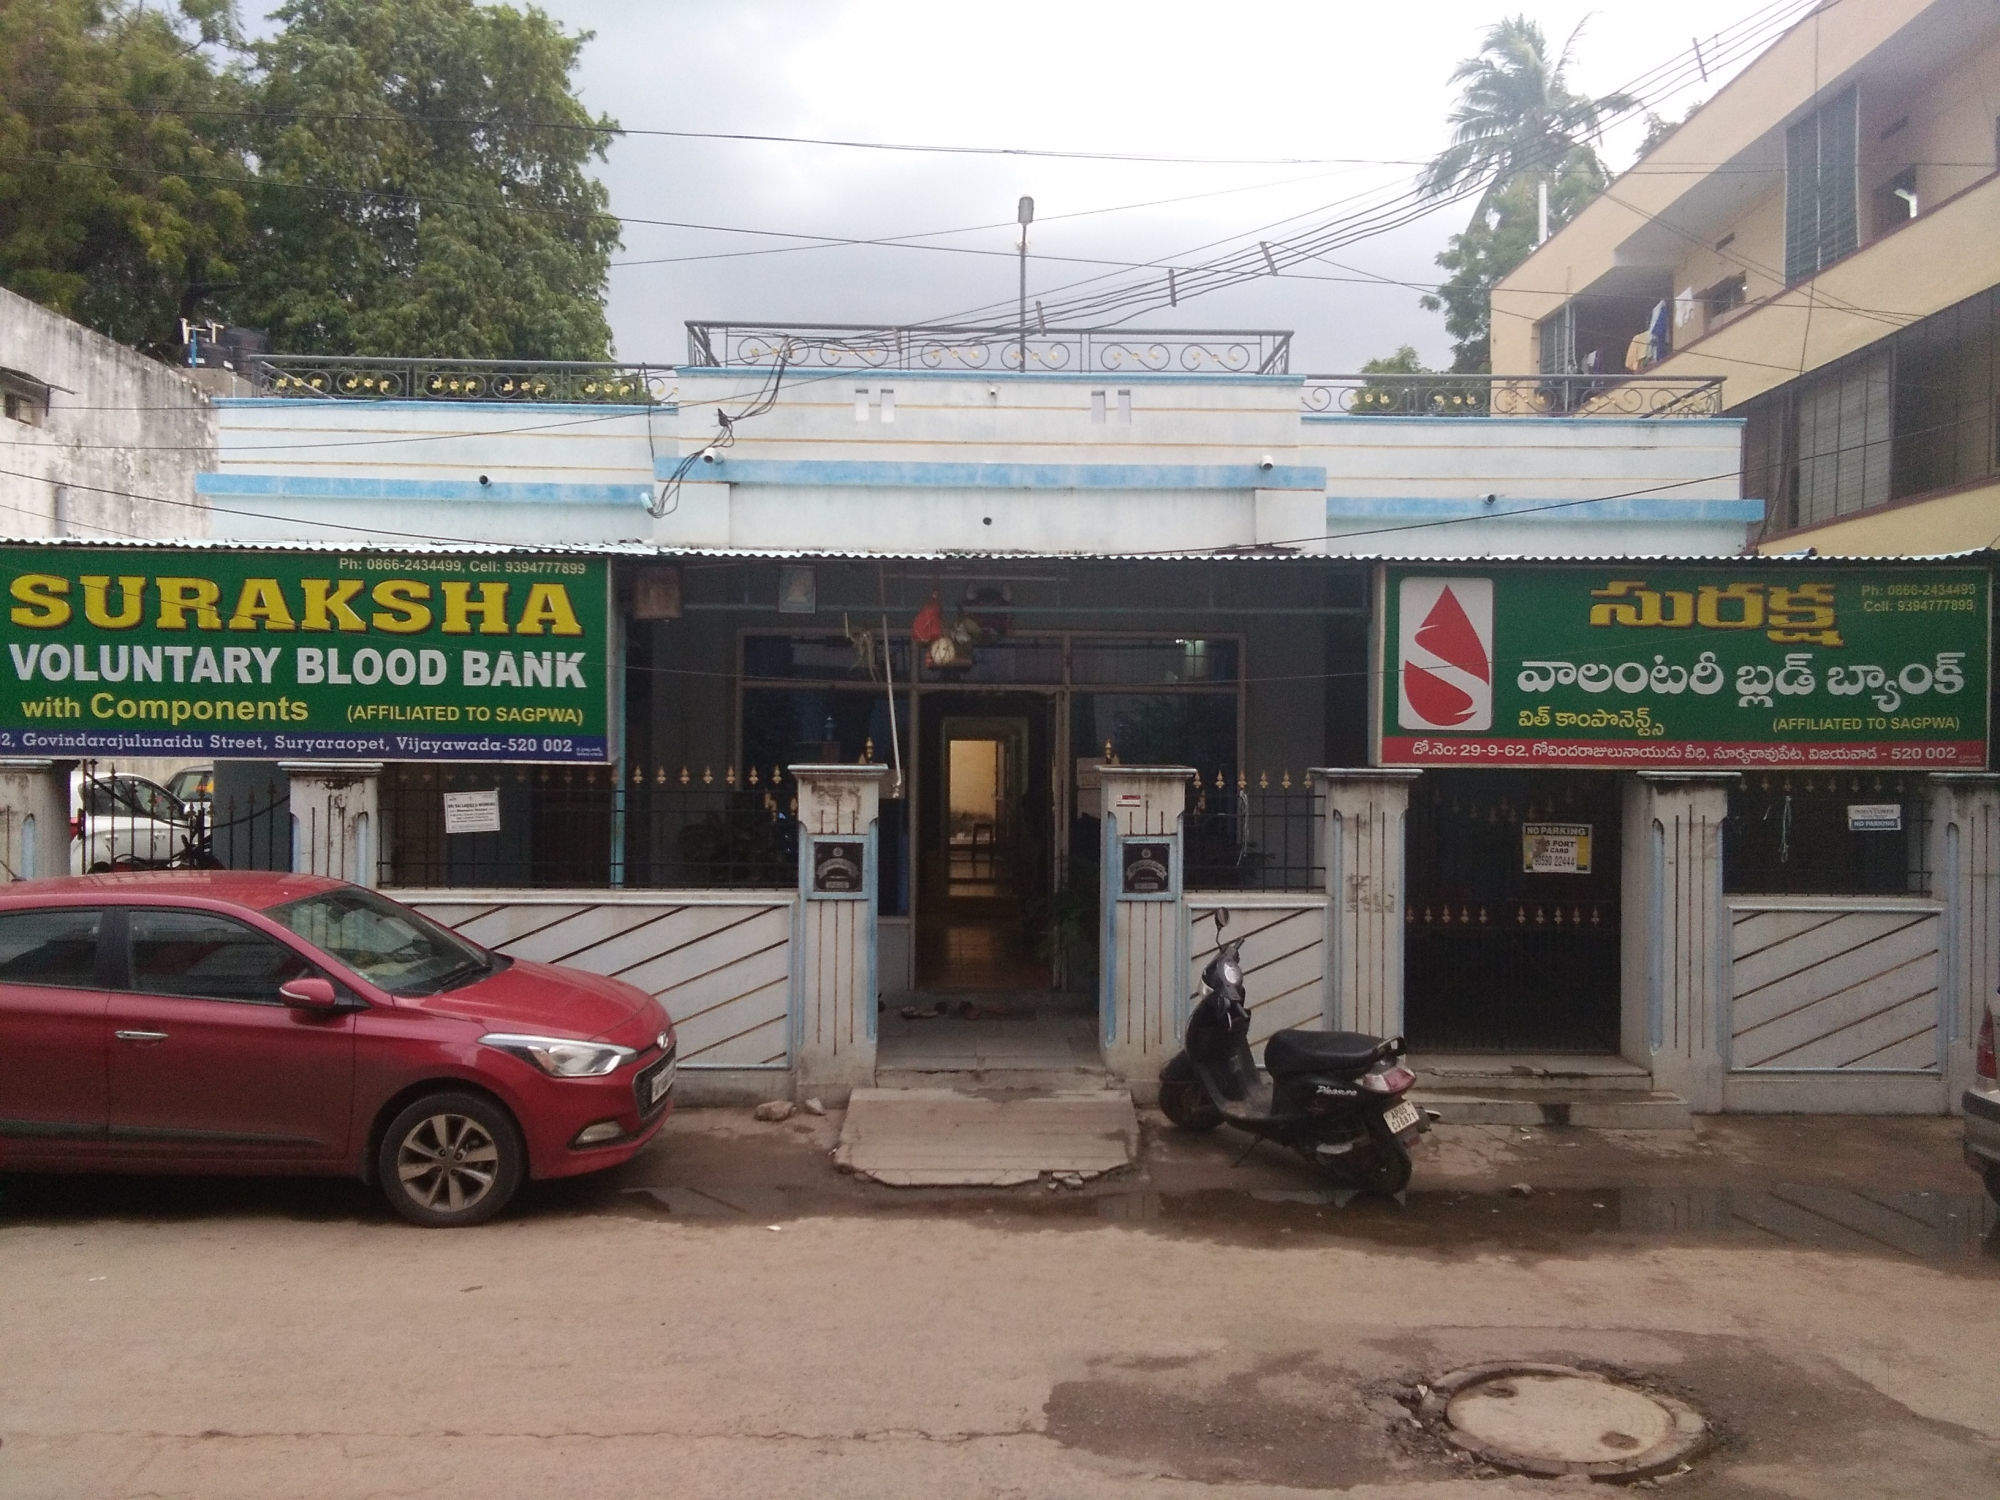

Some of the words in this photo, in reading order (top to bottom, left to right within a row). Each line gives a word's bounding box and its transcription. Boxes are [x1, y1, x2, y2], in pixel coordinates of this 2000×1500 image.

[339, 557, 362, 571] Ph:
[366, 558, 465, 574] 0866-2434499,
[469, 560, 501, 574] Cell:
[505, 561, 586, 575] 9394777899
[9, 572, 584, 636] SURAKSHA
[1589, 580, 1845, 647] సురక్ష
[9, 643, 282, 684] VOLUNTARY
[296, 647, 448, 687] BLOOD
[462, 649, 587, 689] BANK
[1516, 651, 1725, 695] వాలంటరీ
[1735, 653, 1816, 709] బ్లడ్
[1826, 652, 1967, 713] బ్యాంక్
[21, 696, 81, 719] with
[90, 691, 310, 726] Components
[346, 704, 460, 724] (AFFILIATED
[465, 706, 491, 722] TO
[495, 706, 584, 727] SAGPWA)
[1518, 705, 1551, 727] విత్
[1772, 717, 1862, 733] (AFFILIATED
[1866, 718, 1887, 731] TO
[1890, 716, 1961, 732] SAGPWA)
[22, 732, 205, 751] Govindarajulunaidu
[209, 734, 268, 751] Street,
[274, 735, 390, 754] Suryaraopet,
[396, 736, 537, 755] Vijayawada-520
[542, 739, 573, 753] 002
[1808, 746, 1877, 760] విజయవాడ
[1890, 747, 1922, 760] 520
[1925, 746, 1957, 760] 002
[1527, 826, 1540, 835] NO
[1541, 826, 1586, 836] PARKING
